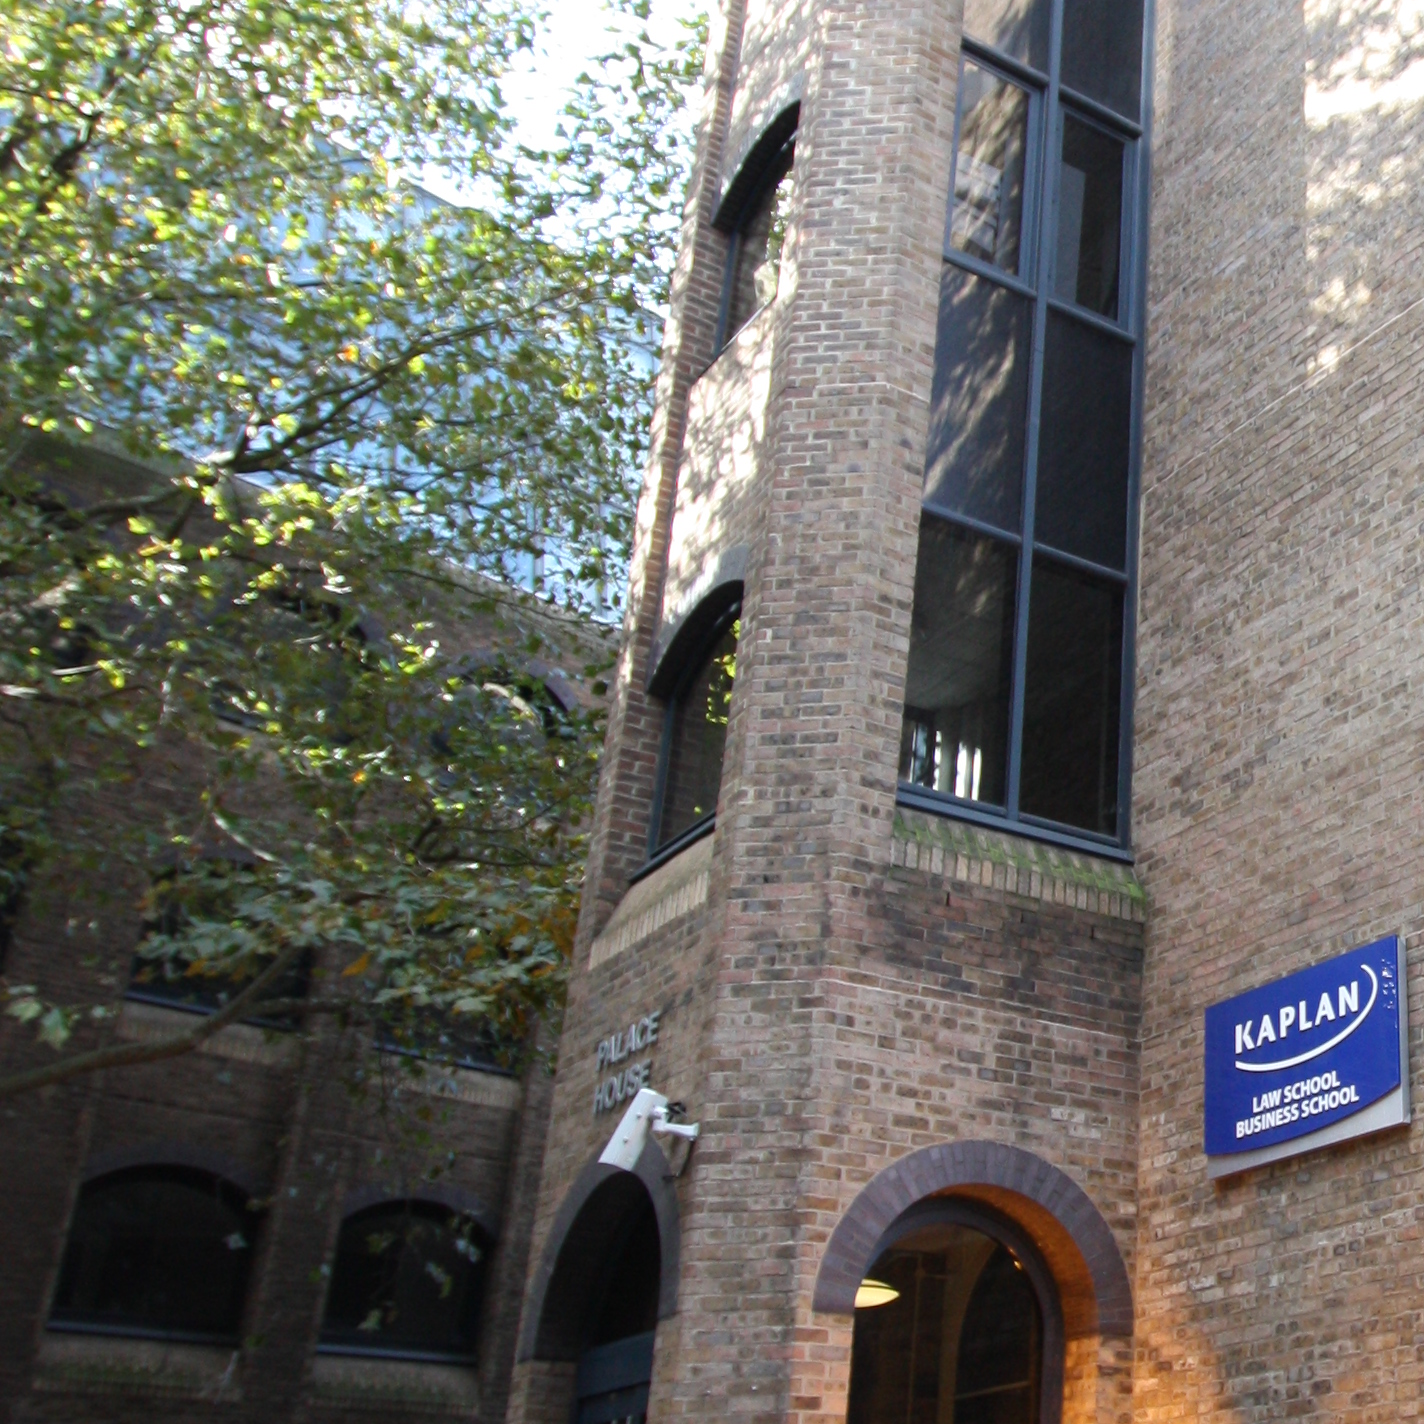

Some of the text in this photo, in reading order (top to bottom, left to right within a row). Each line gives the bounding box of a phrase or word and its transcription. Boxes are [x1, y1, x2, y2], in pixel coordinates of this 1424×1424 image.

[595, 1010, 661, 1073] PALACE
[1234, 980, 1359, 1055] KAPLAN
[593, 1058, 653, 1114] HOUSE
[1235, 1084, 1360, 1139] BUSINESS SCHOOL
[1252, 1070, 1341, 1113] LAW SCHOOL
